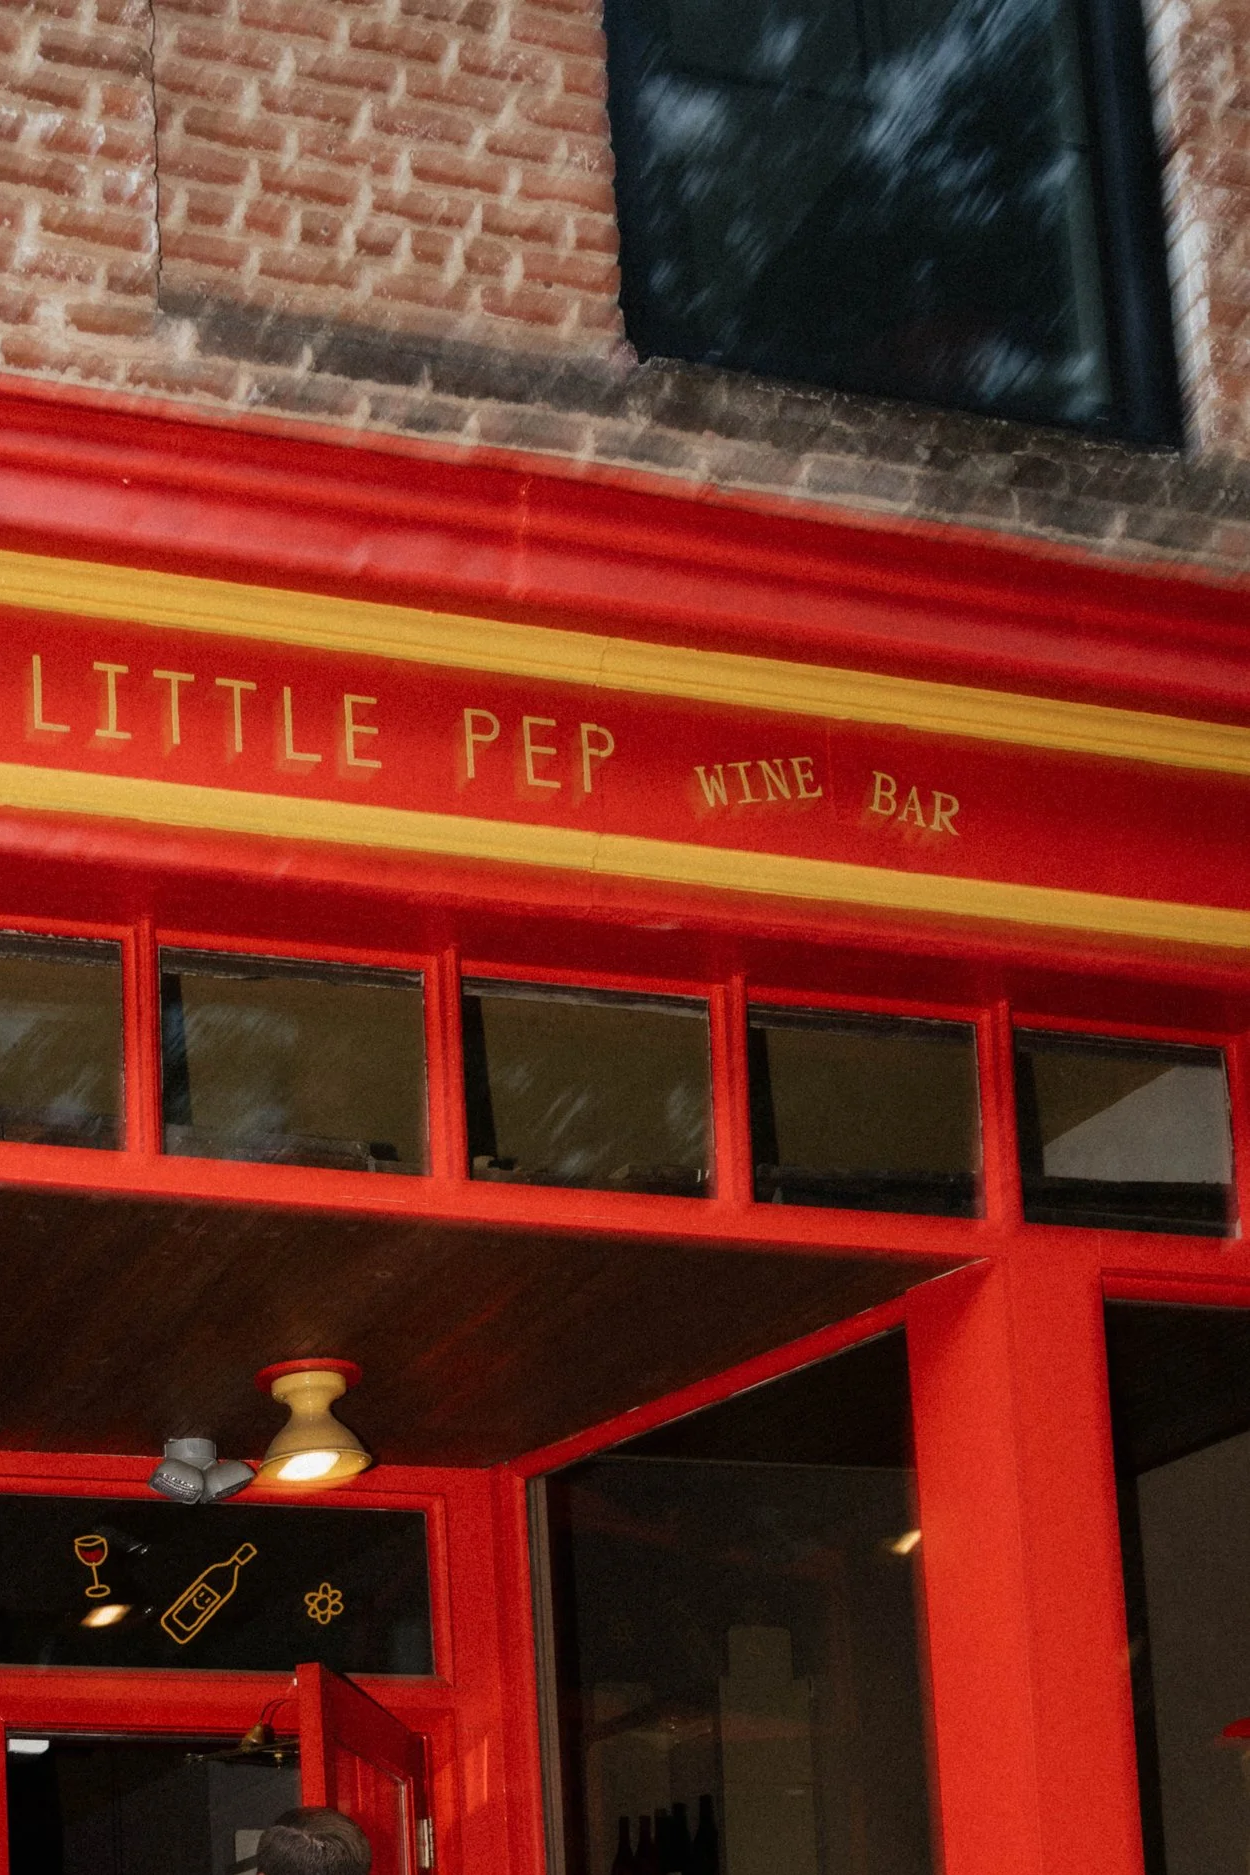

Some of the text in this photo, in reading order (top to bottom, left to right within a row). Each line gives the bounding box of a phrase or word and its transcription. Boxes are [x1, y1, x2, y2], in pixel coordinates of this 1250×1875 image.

[31, 654, 615, 793] LITTLE PEP
[694, 755, 960, 836] WINE BAR
